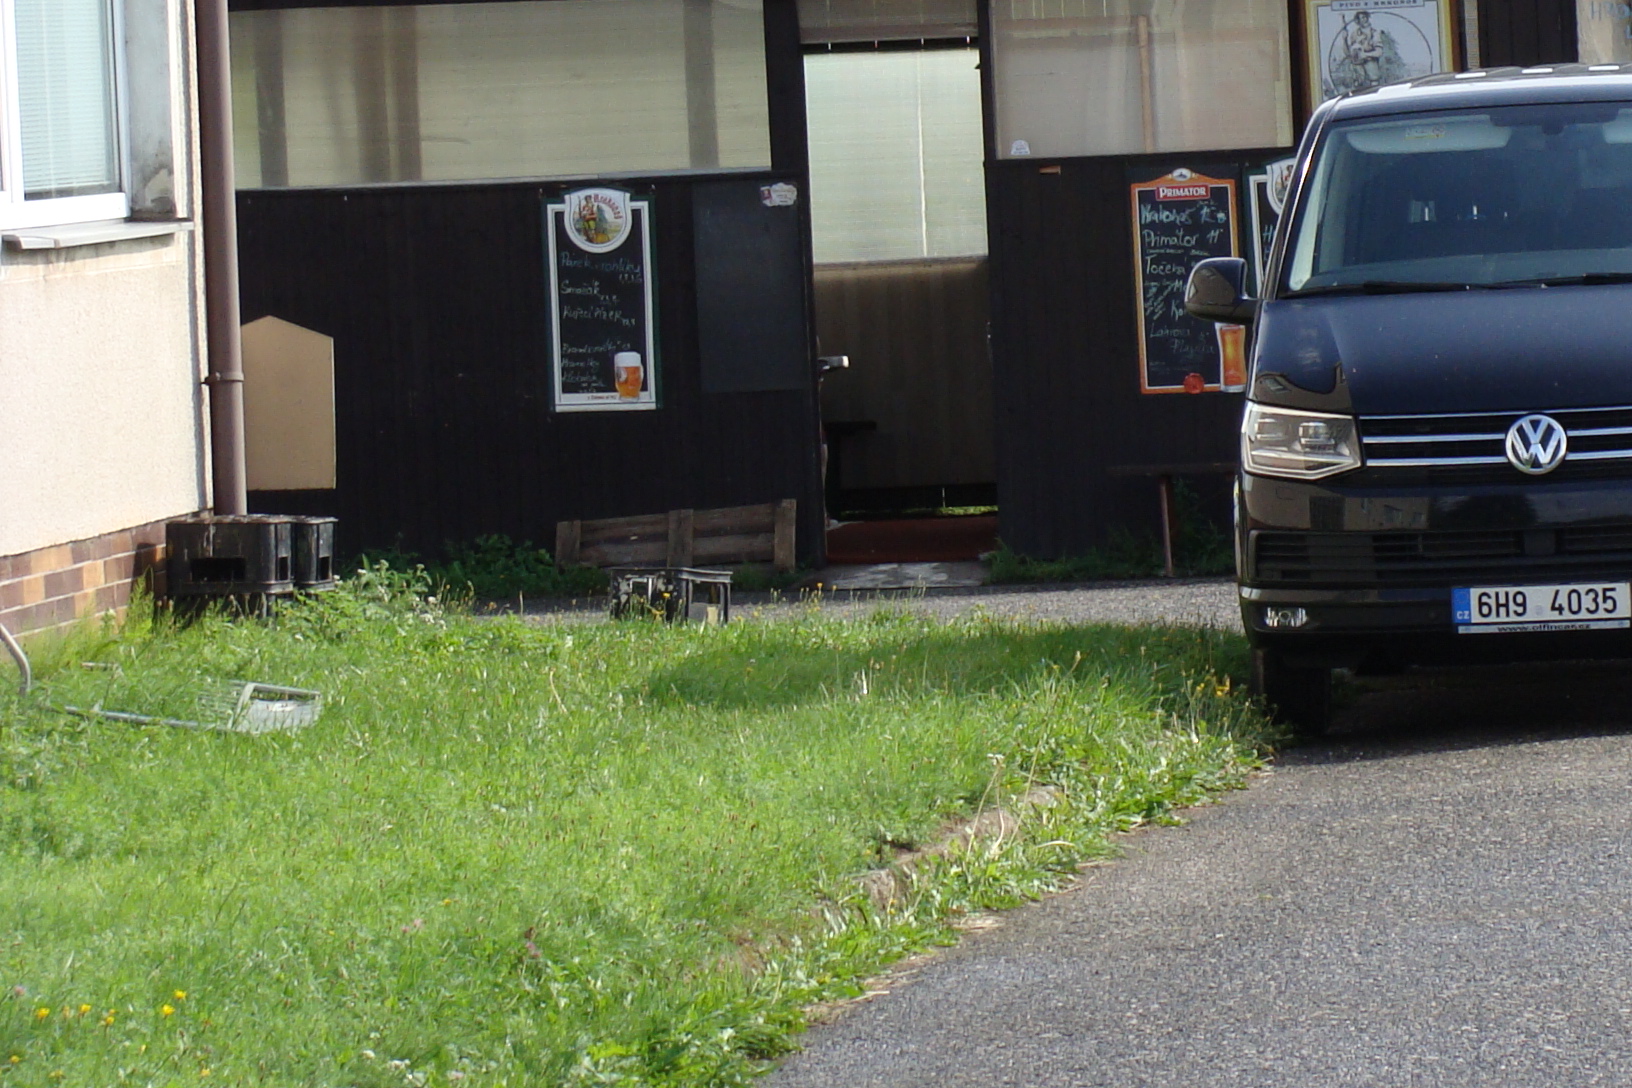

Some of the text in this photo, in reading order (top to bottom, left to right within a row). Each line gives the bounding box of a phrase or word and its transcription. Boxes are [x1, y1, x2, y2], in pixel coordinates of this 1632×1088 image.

[1159, 186, 1207, 198] PRIMATOR
[1477, 586, 1618, 619] 6H9 4035
[1456, 610, 1470, 620] CZ
